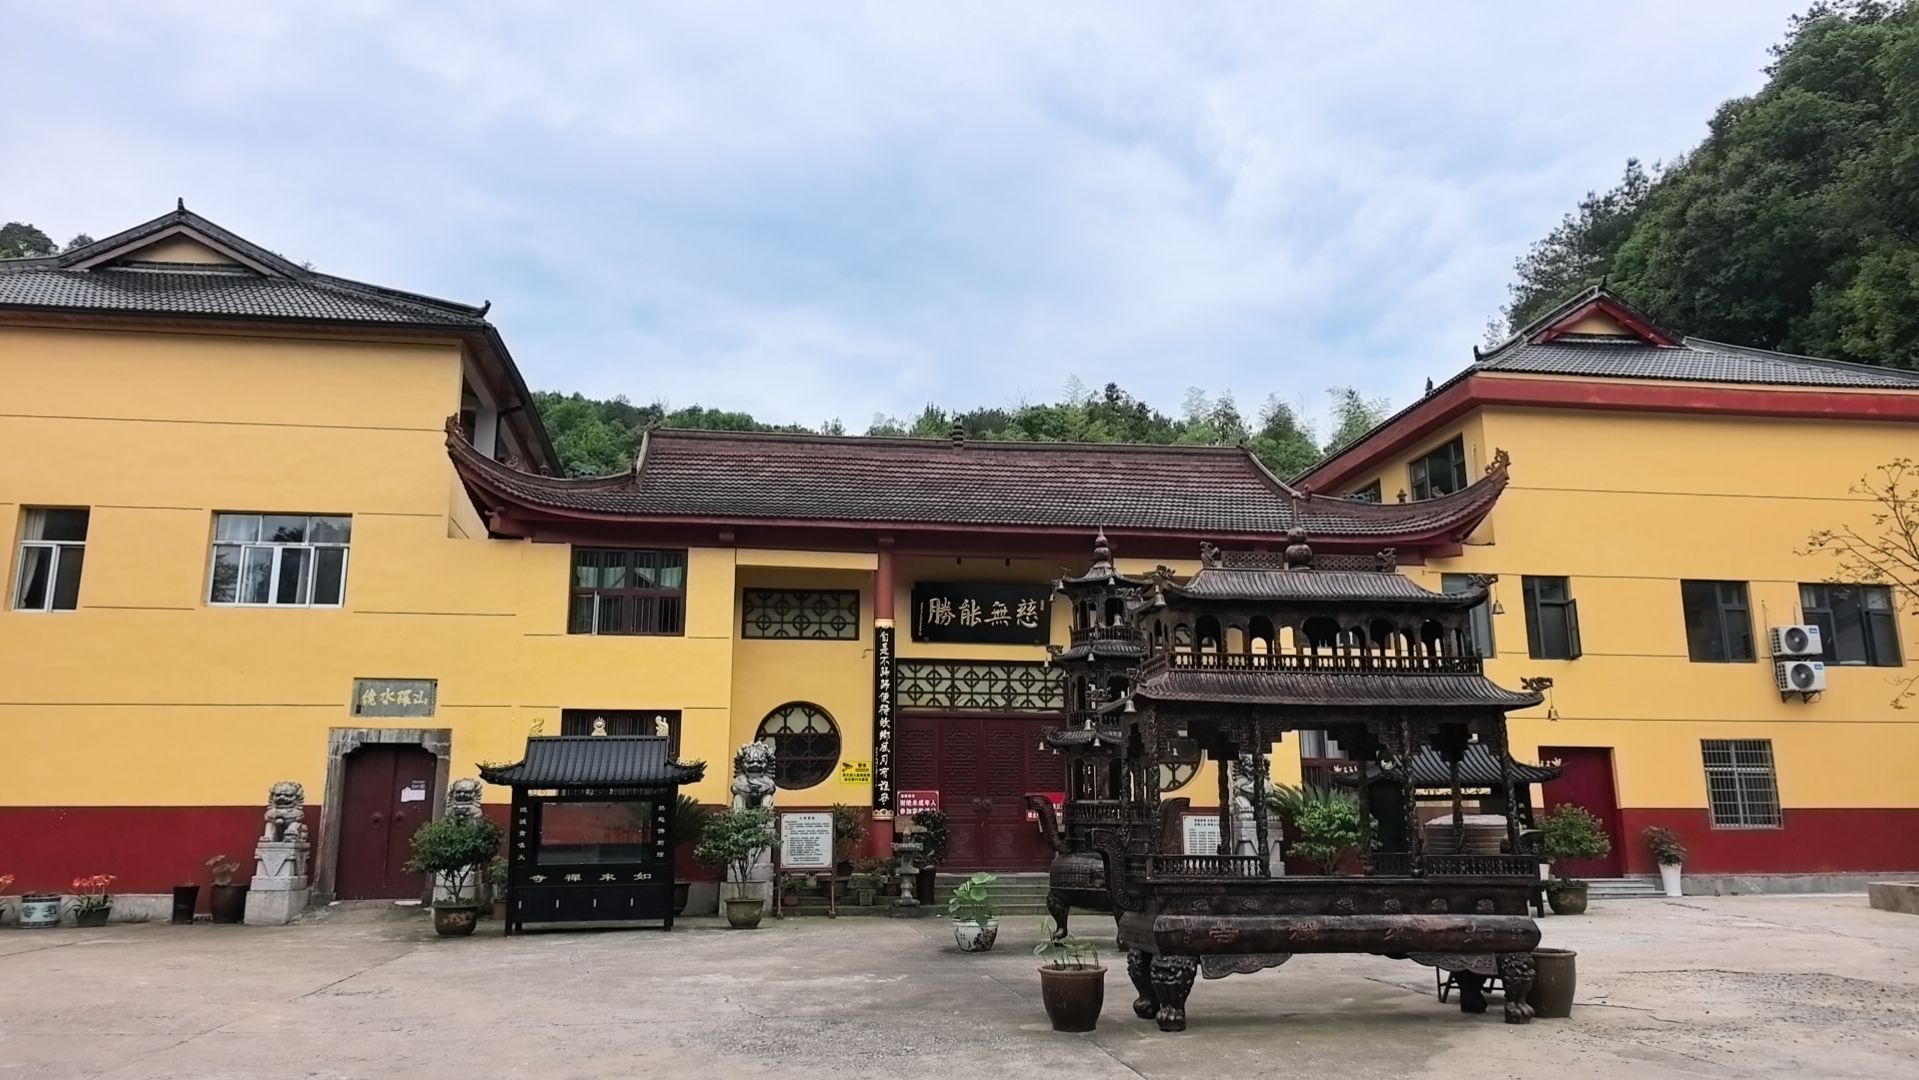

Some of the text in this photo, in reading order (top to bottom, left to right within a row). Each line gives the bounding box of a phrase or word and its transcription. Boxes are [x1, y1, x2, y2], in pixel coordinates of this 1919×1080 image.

[927, 597, 1039, 629] 慈無能勝
[899, 799, 937, 807] 谢绝未成年人
